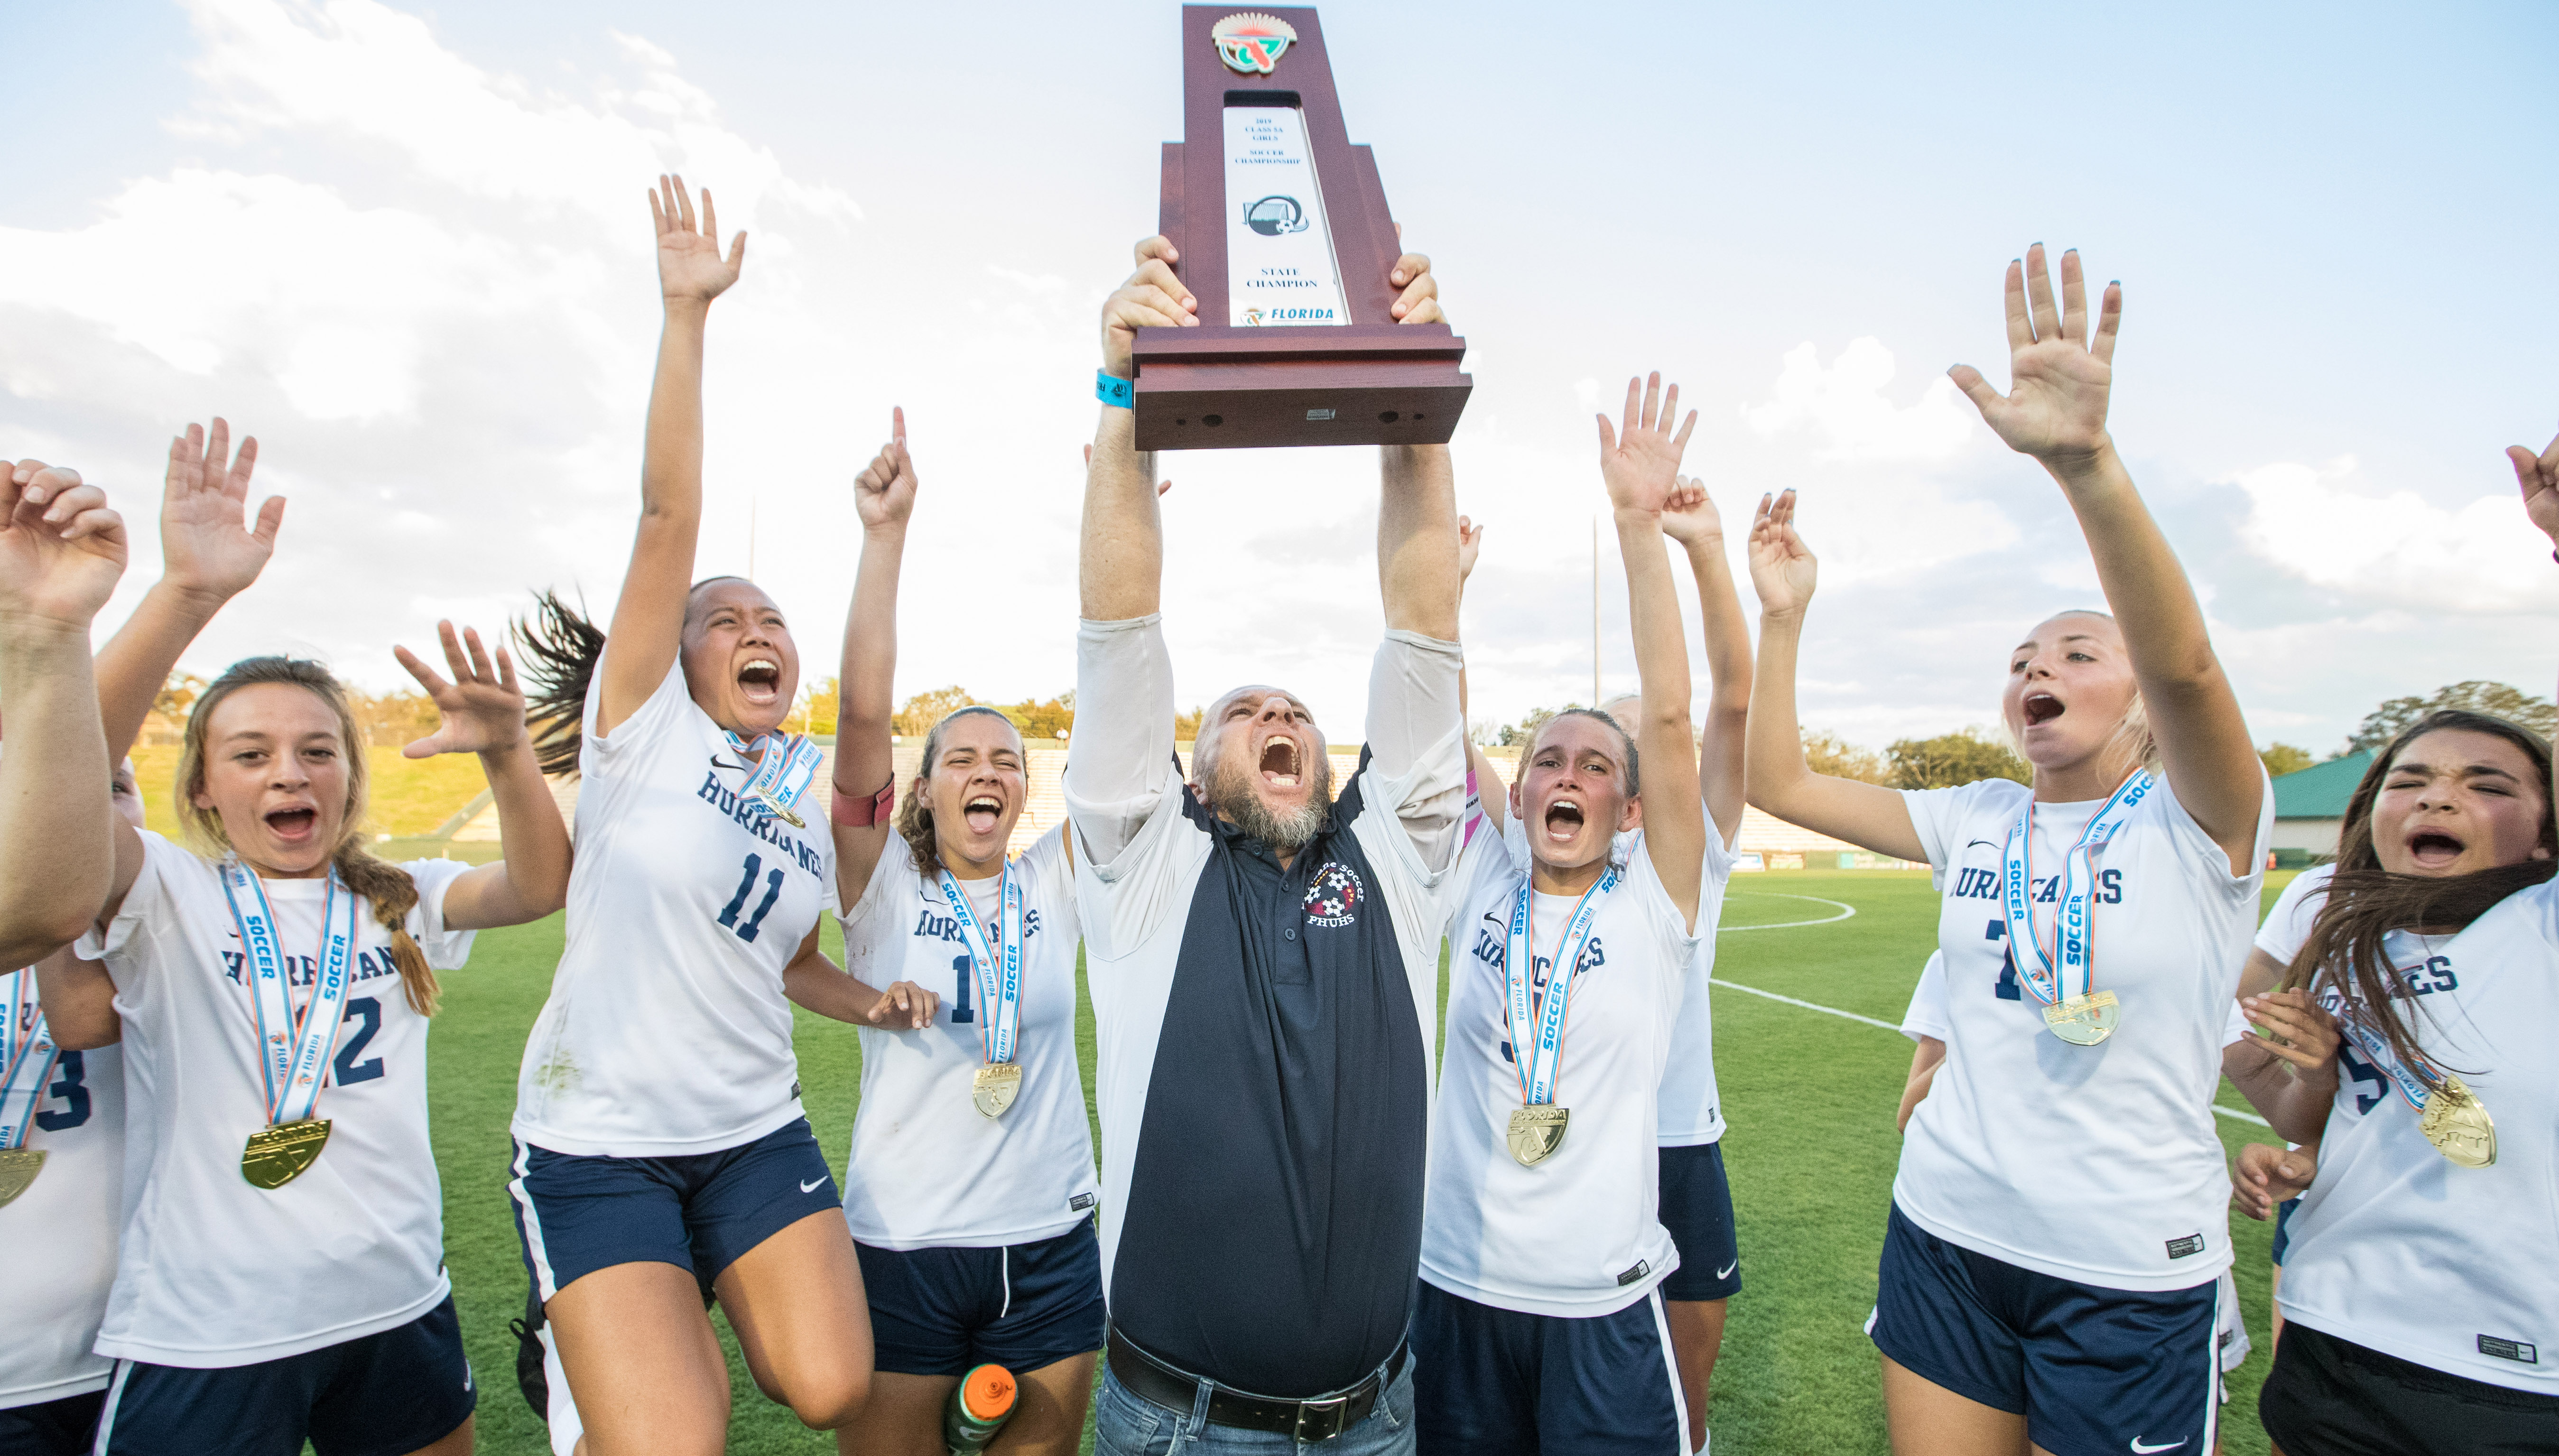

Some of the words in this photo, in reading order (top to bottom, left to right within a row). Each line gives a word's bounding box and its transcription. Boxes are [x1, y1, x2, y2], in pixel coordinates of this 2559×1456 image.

[1271, 309, 1334, 319] FLORIDA
[761, 760, 777, 787] FLORID
[2123, 774, 2154, 807] SOC
[2090, 823, 2106, 842] ORIDA
[717, 853, 785, 943] 11
[942, 883, 971, 927] SOCCER
[2010, 860, 2024, 921] SOCCER
[1307, 914, 1354, 927] PHUHS
[1513, 889, 1526, 936] SOCCER
[1576, 907, 1593, 929] FLORIDA
[2066, 895, 2084, 966] SOCCER
[245, 916, 275, 979] SOCCER
[1985, 919, 2021, 1001] 7
[324, 935, 346, 1002] SOCCER
[985, 969, 996, 997] FLORIDA
[1005, 945, 1017, 1002] SOCCER
[1516, 990, 1525, 1020] FLORIDA
[1543, 982, 1564, 1052] SOCCER
[302, 1034, 320, 1070] FLORIDA
[999, 1029, 1007, 1059] FLORIDA
[277, 1048, 287, 1078] FLORI
[1535, 1081, 1543, 1104] ORIDA
[1511, 1110, 1566, 1120] FLORIDA
